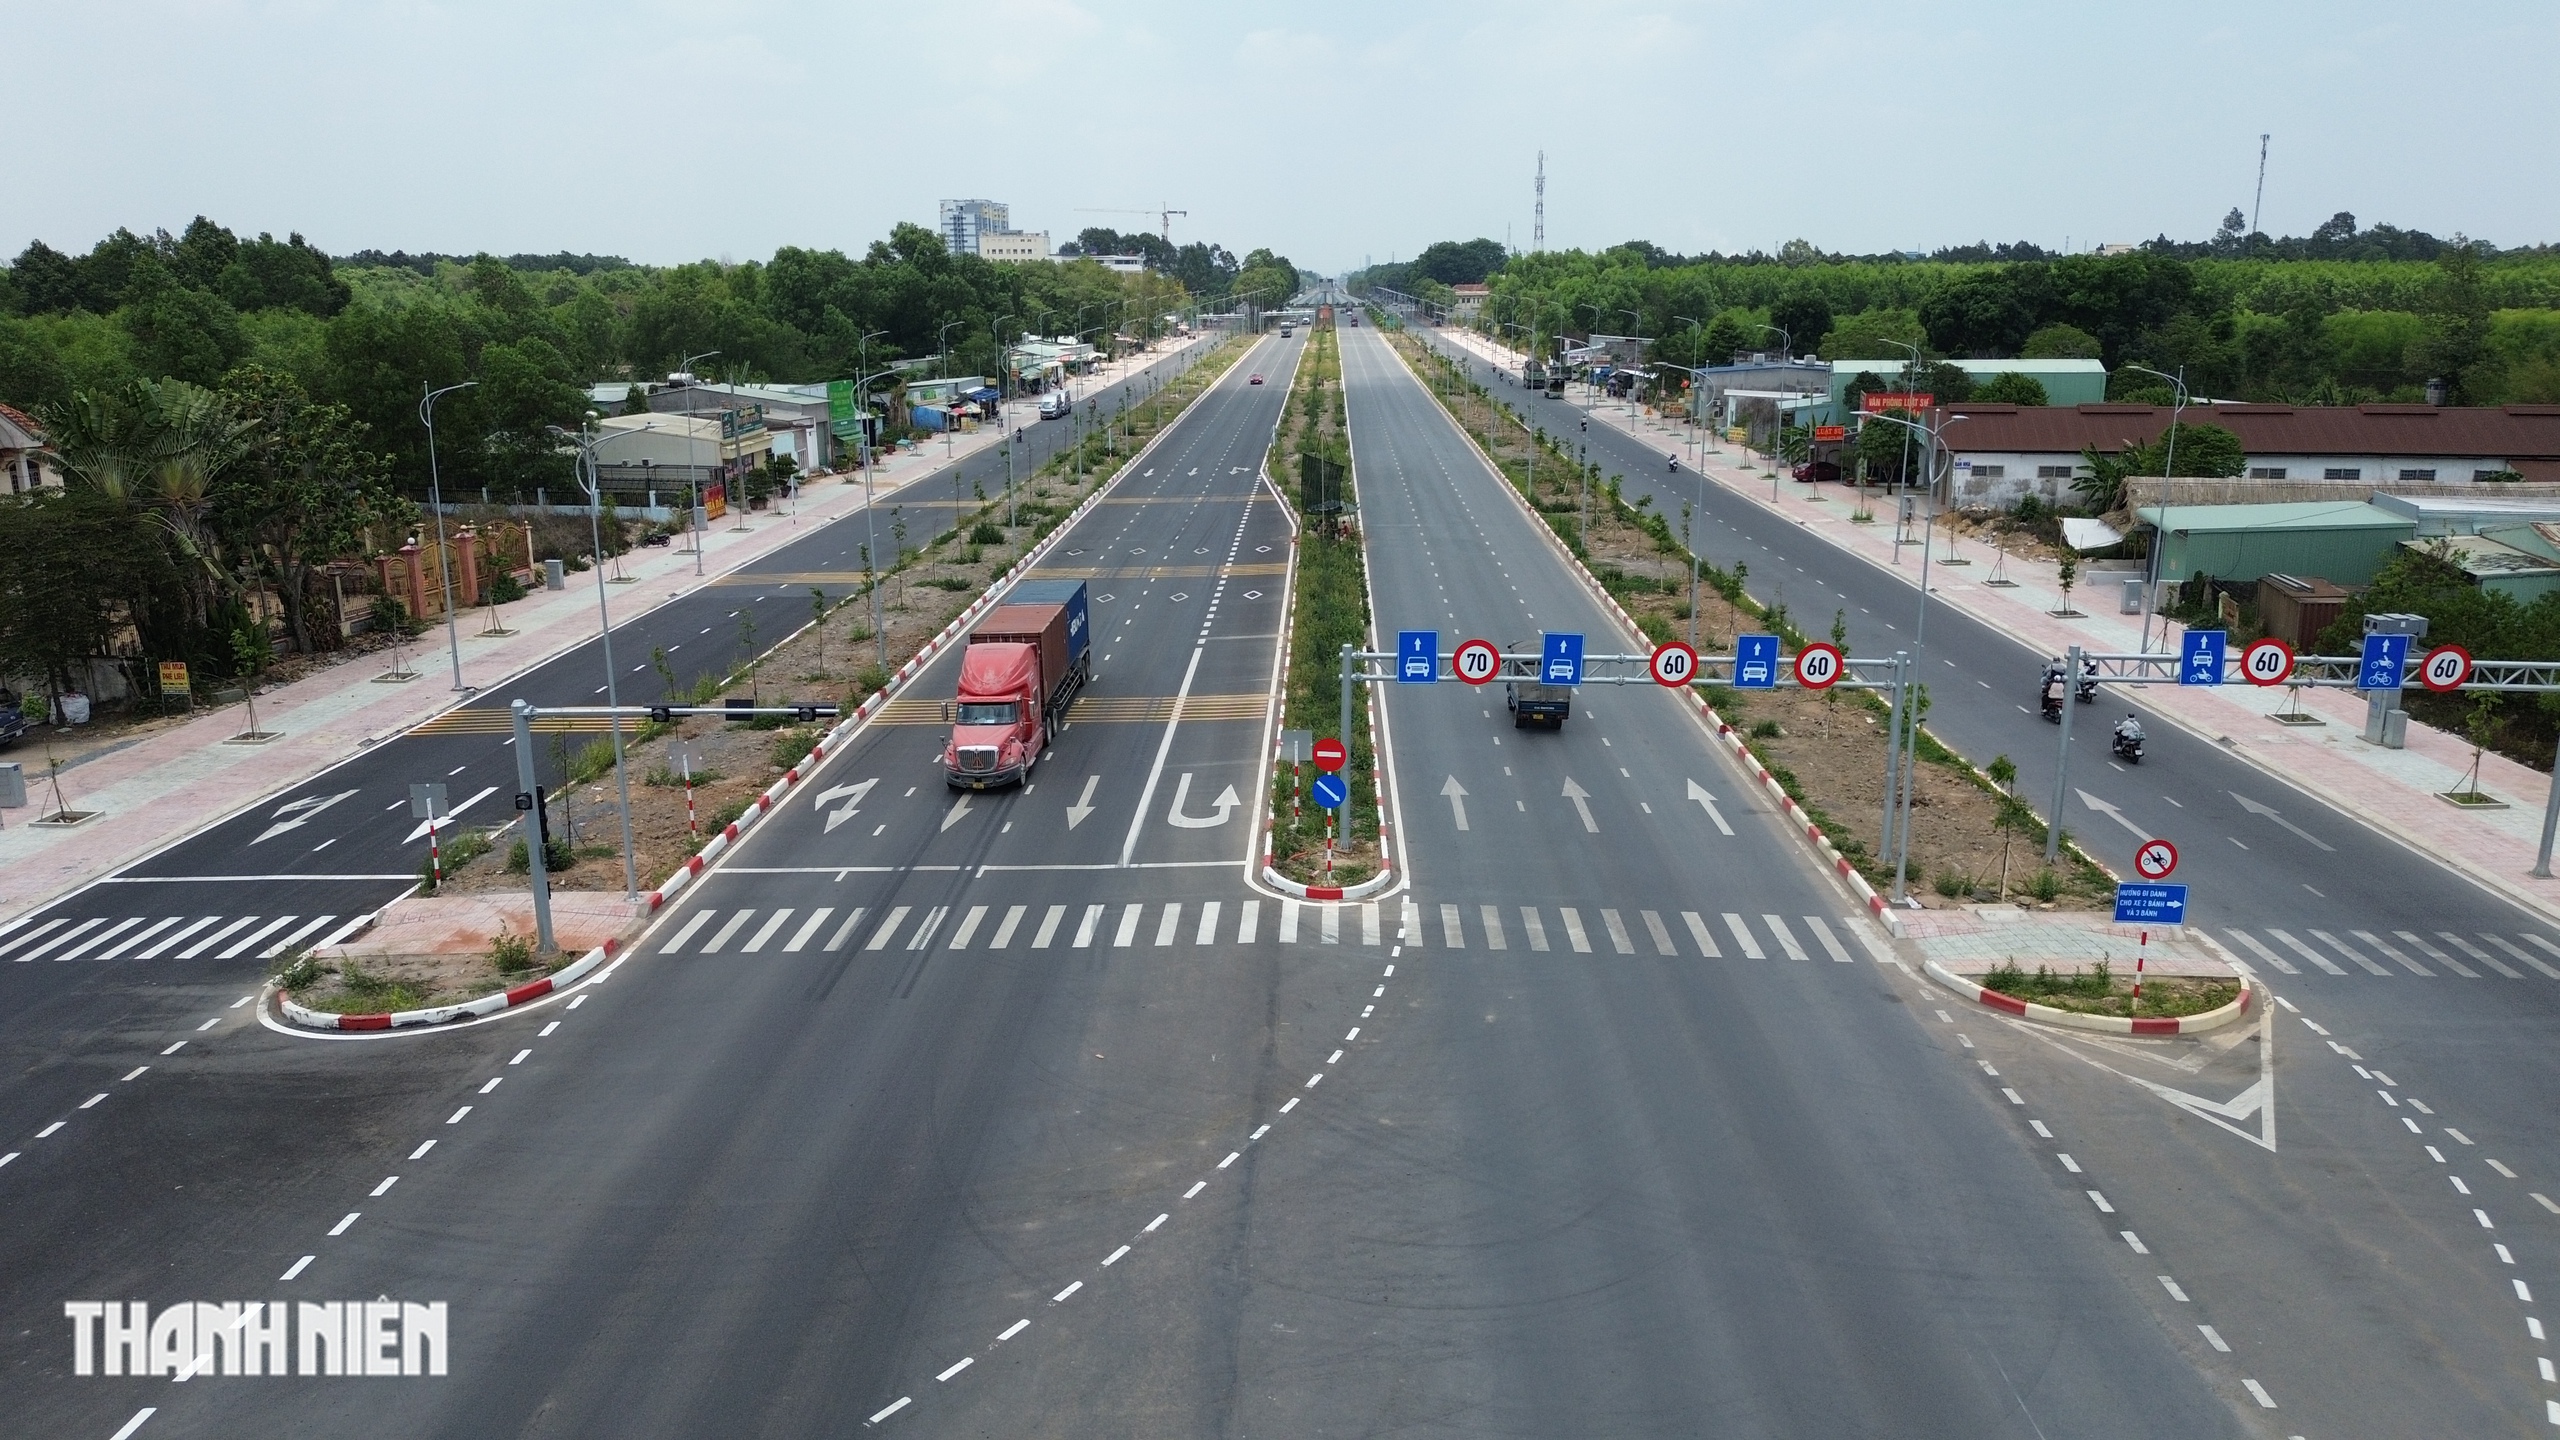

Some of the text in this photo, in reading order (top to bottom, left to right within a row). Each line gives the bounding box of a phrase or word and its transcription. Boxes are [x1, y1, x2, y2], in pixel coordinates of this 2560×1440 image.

[1868, 397, 1881, 406] VĂN
[1882, 396, 1903, 406] PHÒNG
[1919, 397, 1930, 407] SƯ
[1467, 653, 1487, 672] 70
[1663, 655, 1684, 674] 60
[1806, 656, 1828, 676] 60
[2254, 652, 2279, 673] 60
[2433, 658, 2458, 679] 60
[2120, 888, 2141, 897] HƯỚNG
[2150, 889, 2167, 898] DÀNH
[2148, 898, 2165, 907] BÁNH
[2126, 908, 2134, 916] VÀ
[2141, 909, 2158, 917] BÁNH
